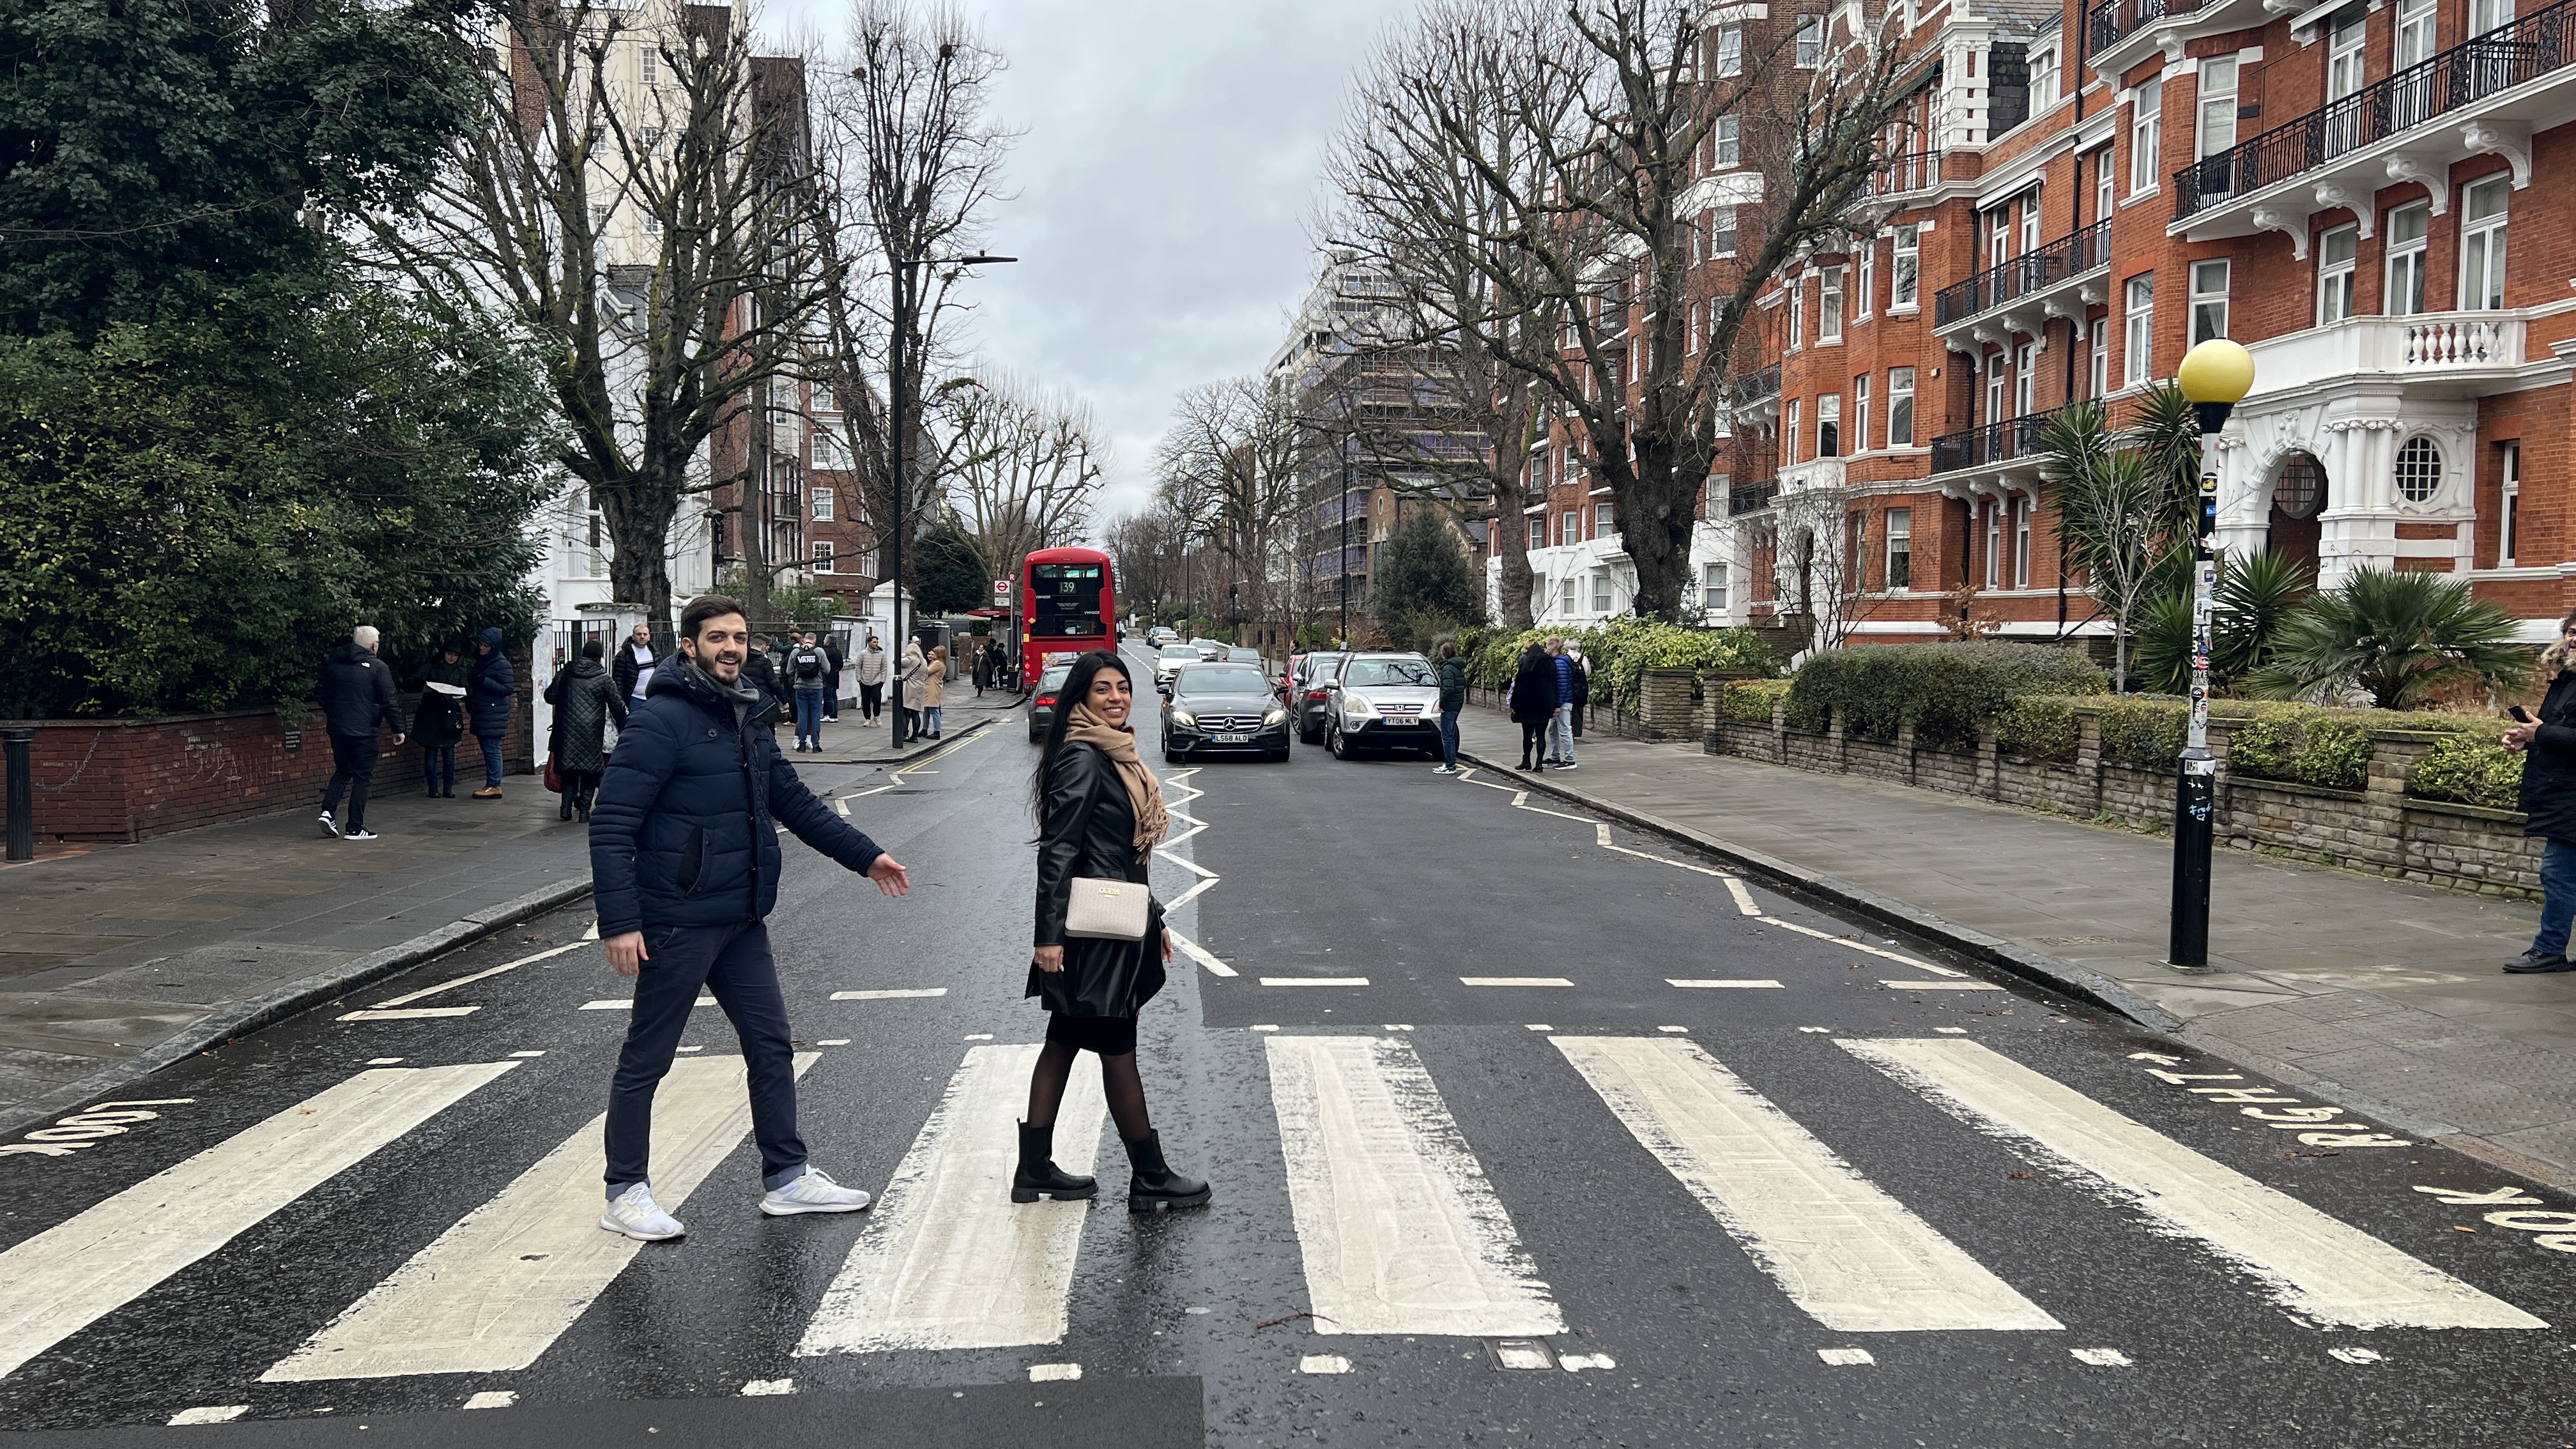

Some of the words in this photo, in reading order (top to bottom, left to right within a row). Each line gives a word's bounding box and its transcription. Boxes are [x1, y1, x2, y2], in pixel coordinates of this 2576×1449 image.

[1060, 582, 1075, 592] 139
[0, 1098, 196, 1157] LOOK
[2144, 1068, 2412, 1147] RIGHT
